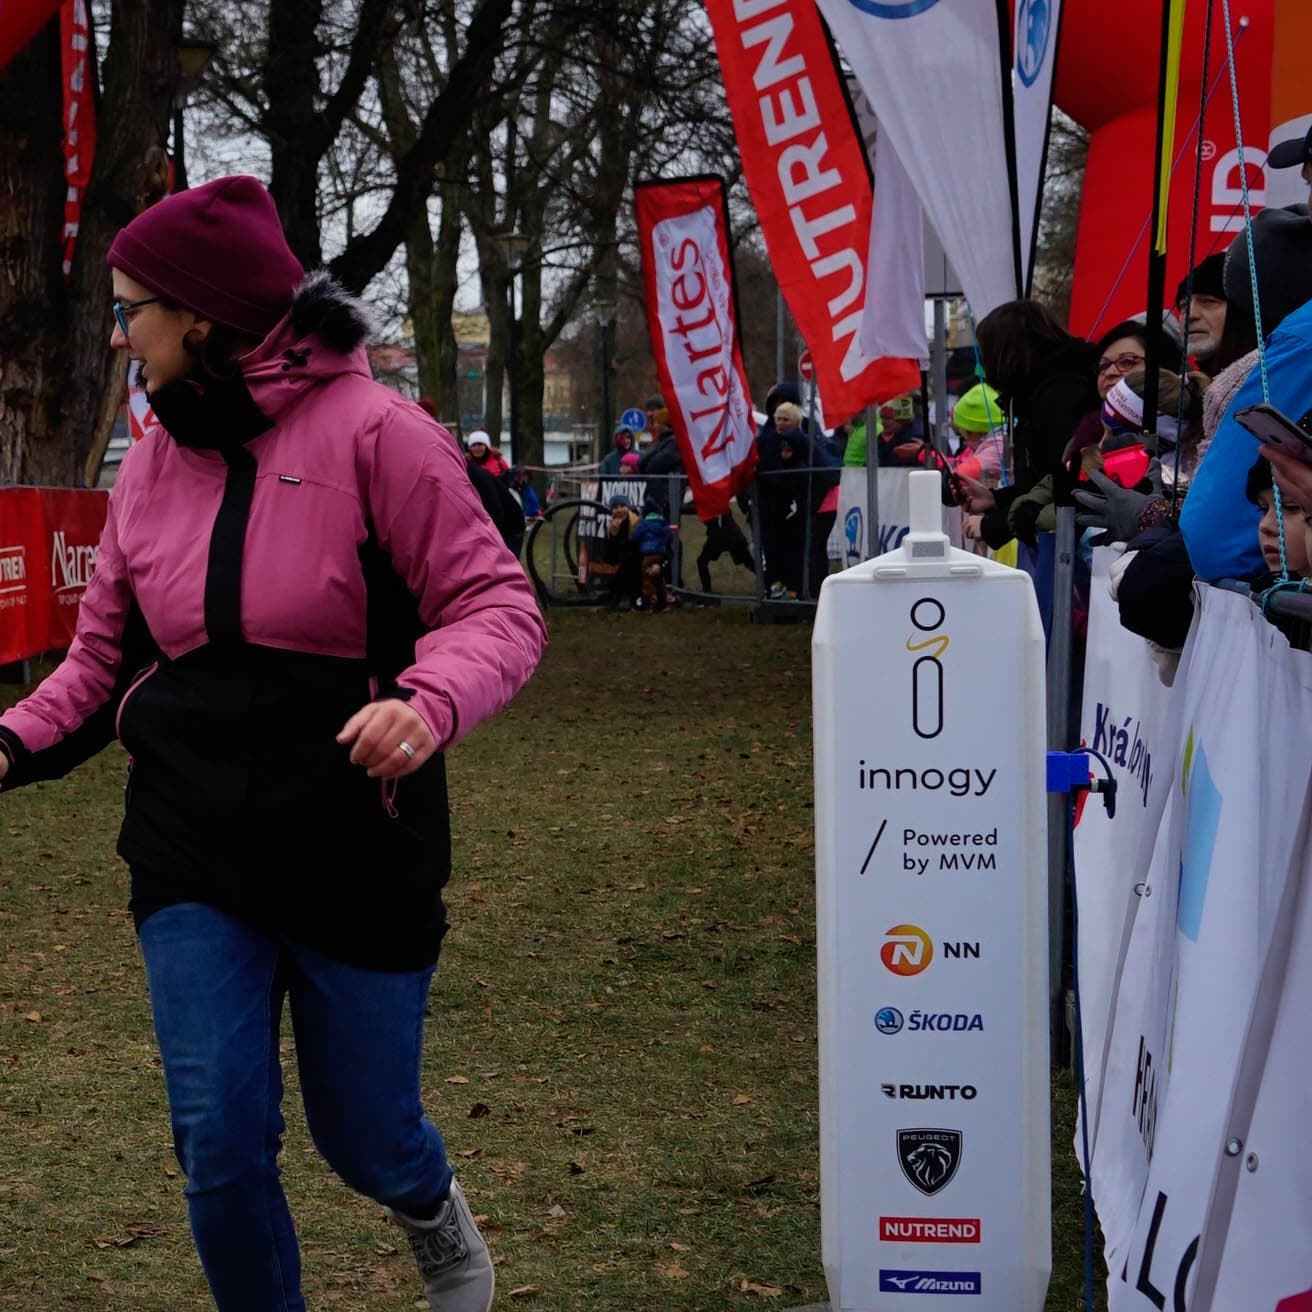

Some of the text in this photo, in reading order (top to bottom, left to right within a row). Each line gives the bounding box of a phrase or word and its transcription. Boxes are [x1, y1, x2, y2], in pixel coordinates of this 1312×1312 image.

[668, 237, 735, 462] Nartes
[859, 759, 997, 796] innogy
[903, 827, 998, 846] Powered
[903, 852, 996, 876] by MVM
[943, 942, 980, 959] NN
[908, 1009, 985, 1032] ŠKODA
[899, 1085, 978, 1101] RUNTO
[885, 1222, 977, 1238] NUTREND
